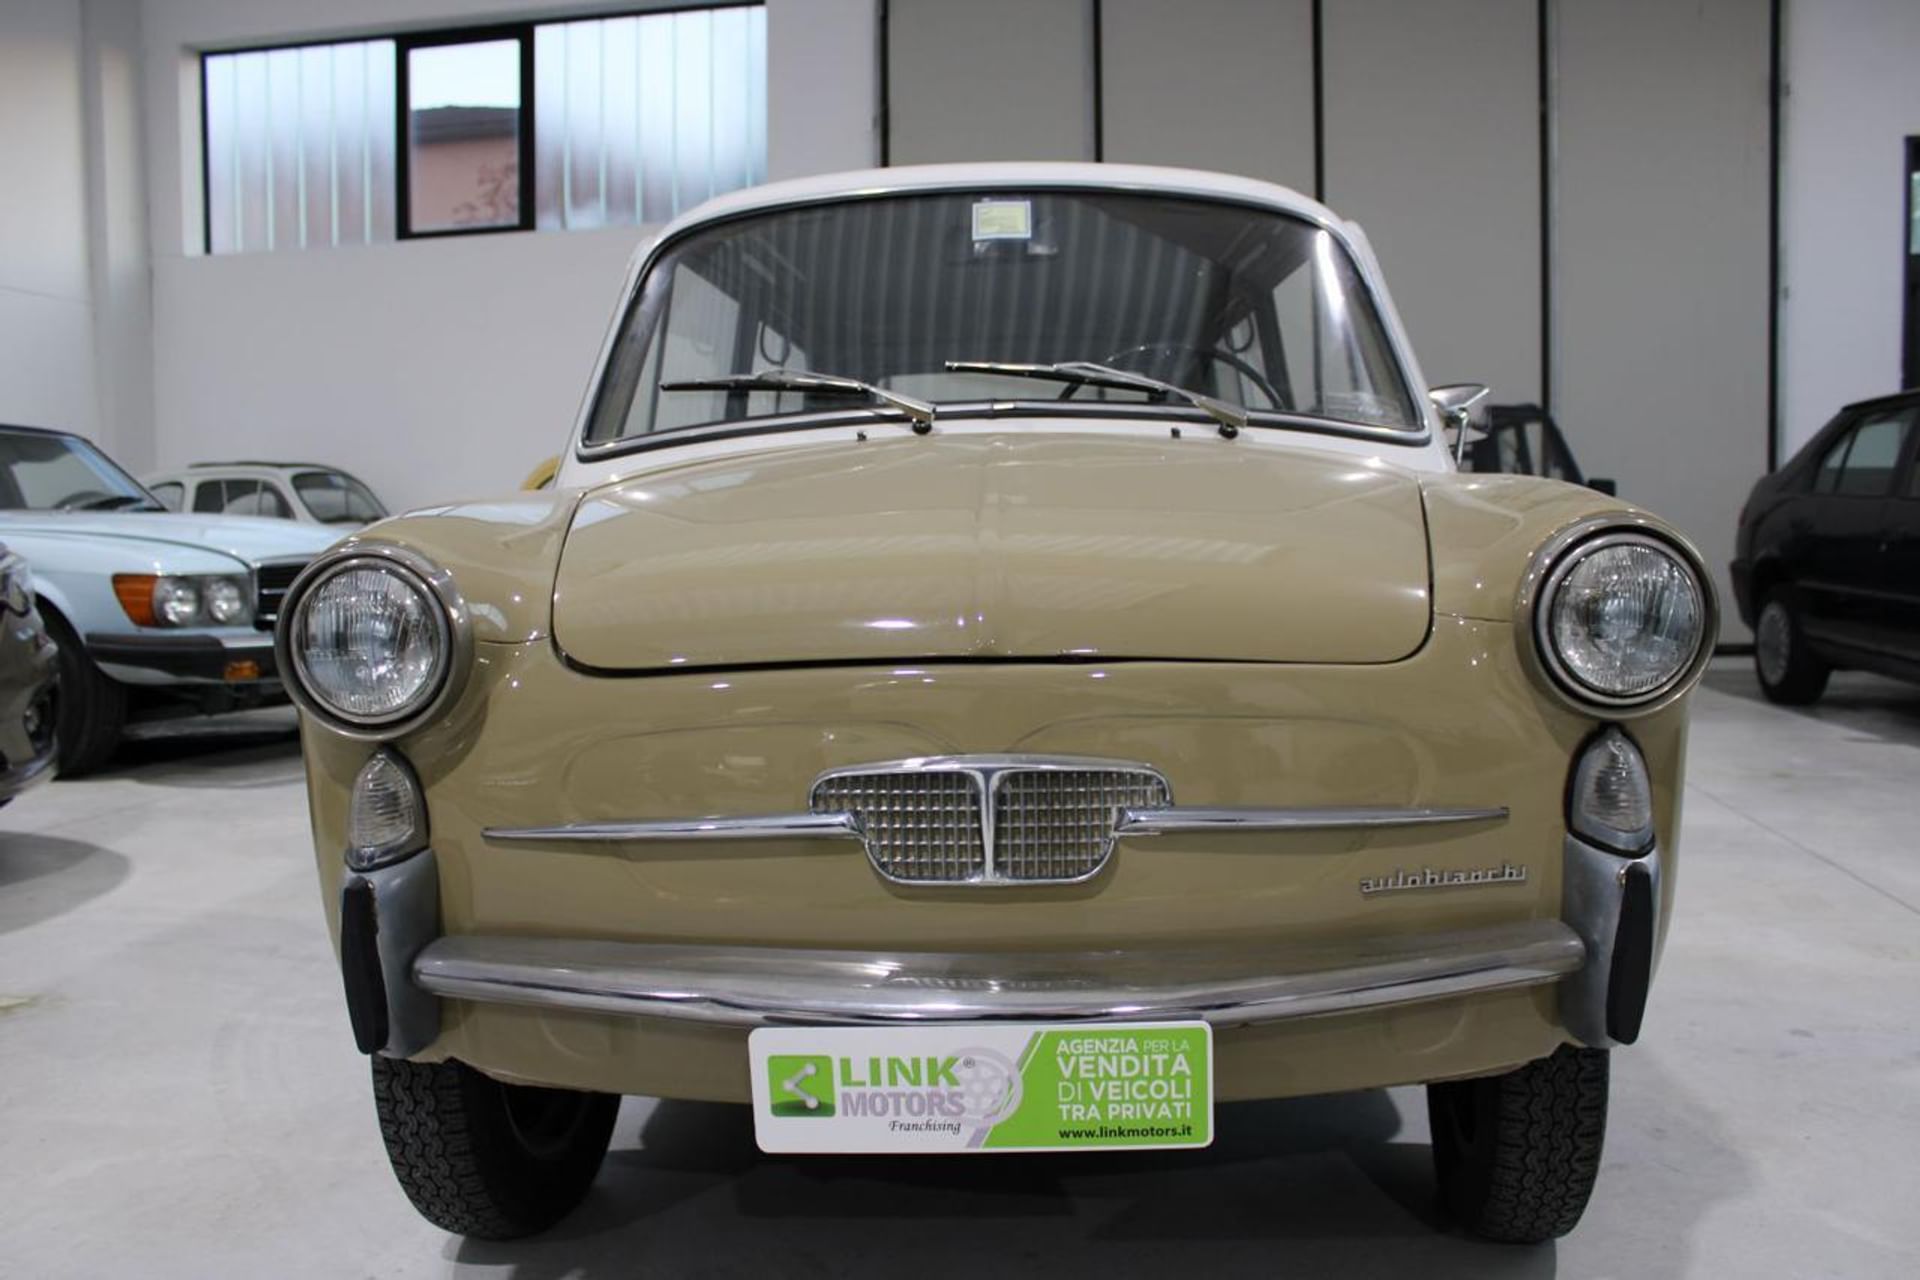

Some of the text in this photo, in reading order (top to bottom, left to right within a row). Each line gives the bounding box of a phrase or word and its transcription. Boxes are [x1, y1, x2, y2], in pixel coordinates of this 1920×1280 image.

[1360, 864, 1527, 893] autobianchi
[1056, 1038, 1190, 1055] AGENZIA PER LA
[839, 1056, 961, 1088] LINK
[1057, 1054, 1191, 1078] VENDITA
[1058, 1079, 1191, 1101] DI VEICOLI
[841, 1091, 967, 1117] MOTORS
[1059, 1102, 1191, 1120] TRA PRIVATI
[888, 1120, 961, 1135] Franchising
[1059, 1124, 1192, 1138] www.linkmotors.it
